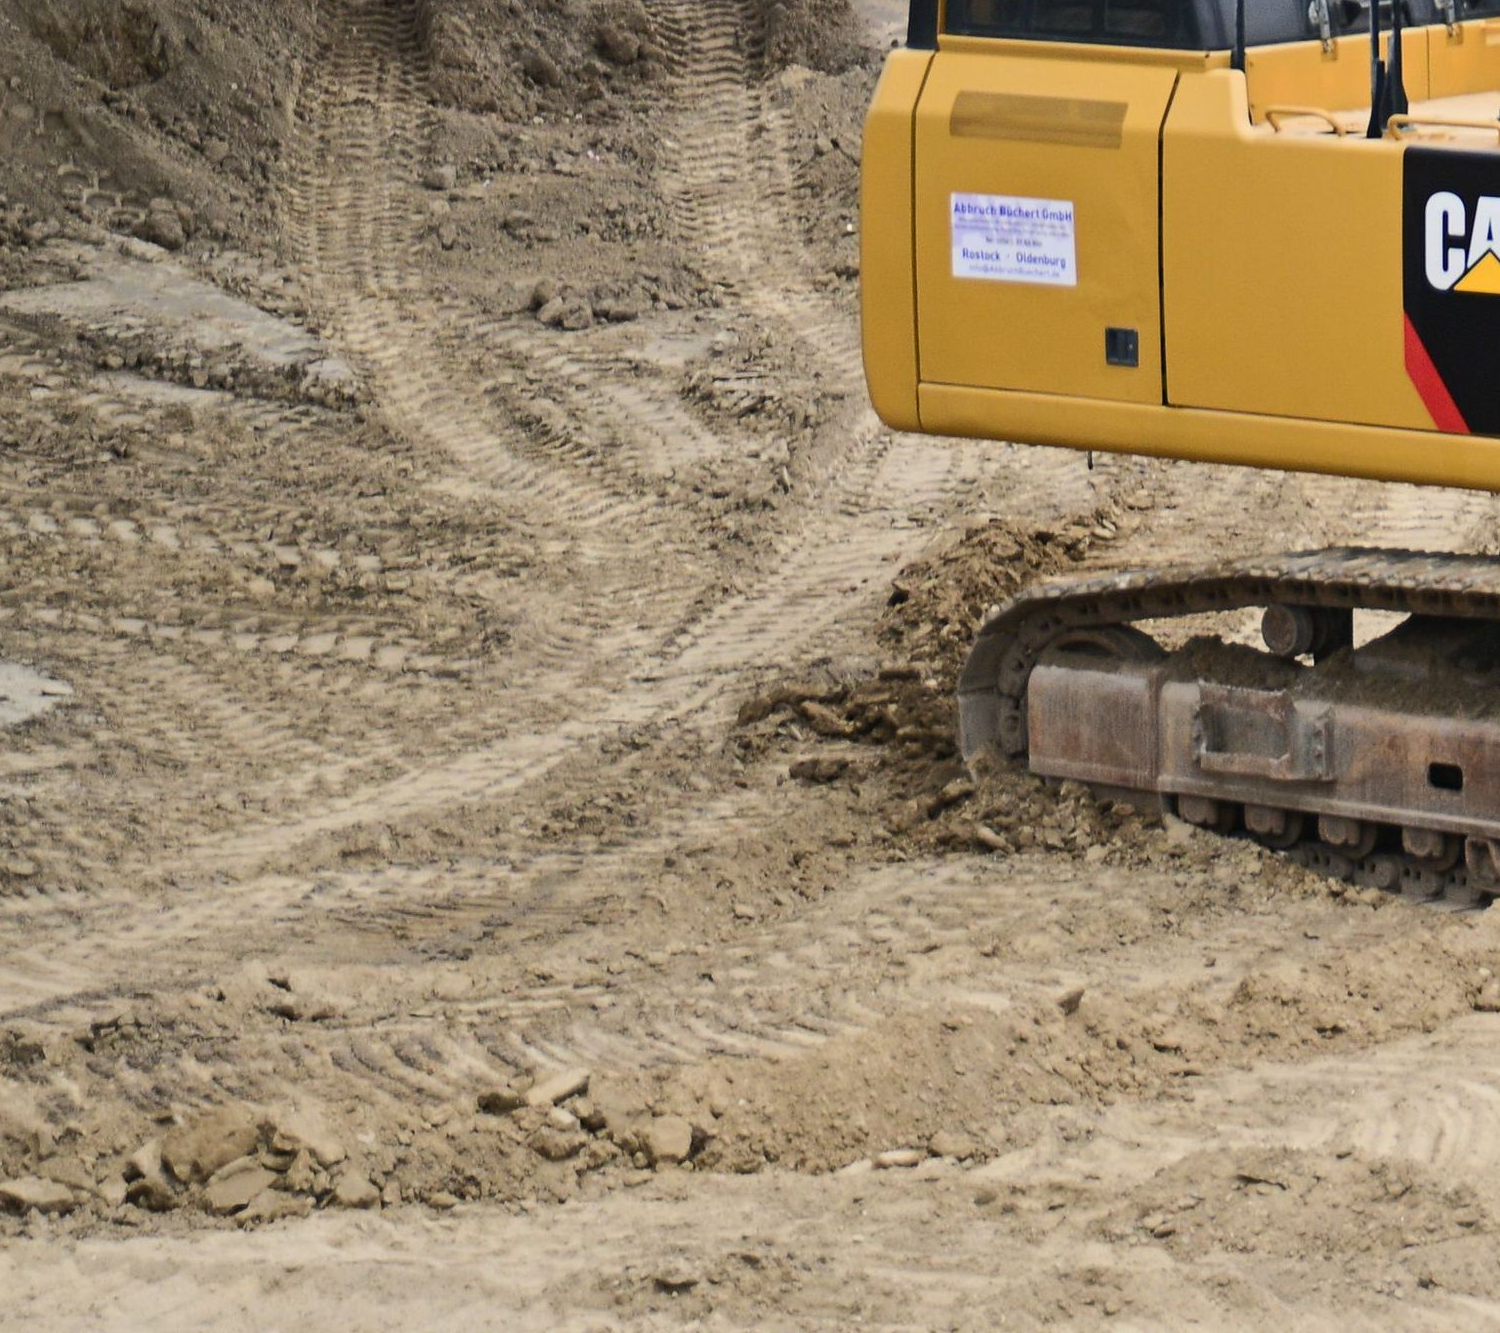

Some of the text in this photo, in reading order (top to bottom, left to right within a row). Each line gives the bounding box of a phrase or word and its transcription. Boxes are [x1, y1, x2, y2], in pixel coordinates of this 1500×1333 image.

[954, 202, 1072, 221] Abbruch Büchert GmbH
[962, 247, 1067, 269] Rostock Oldenburg
